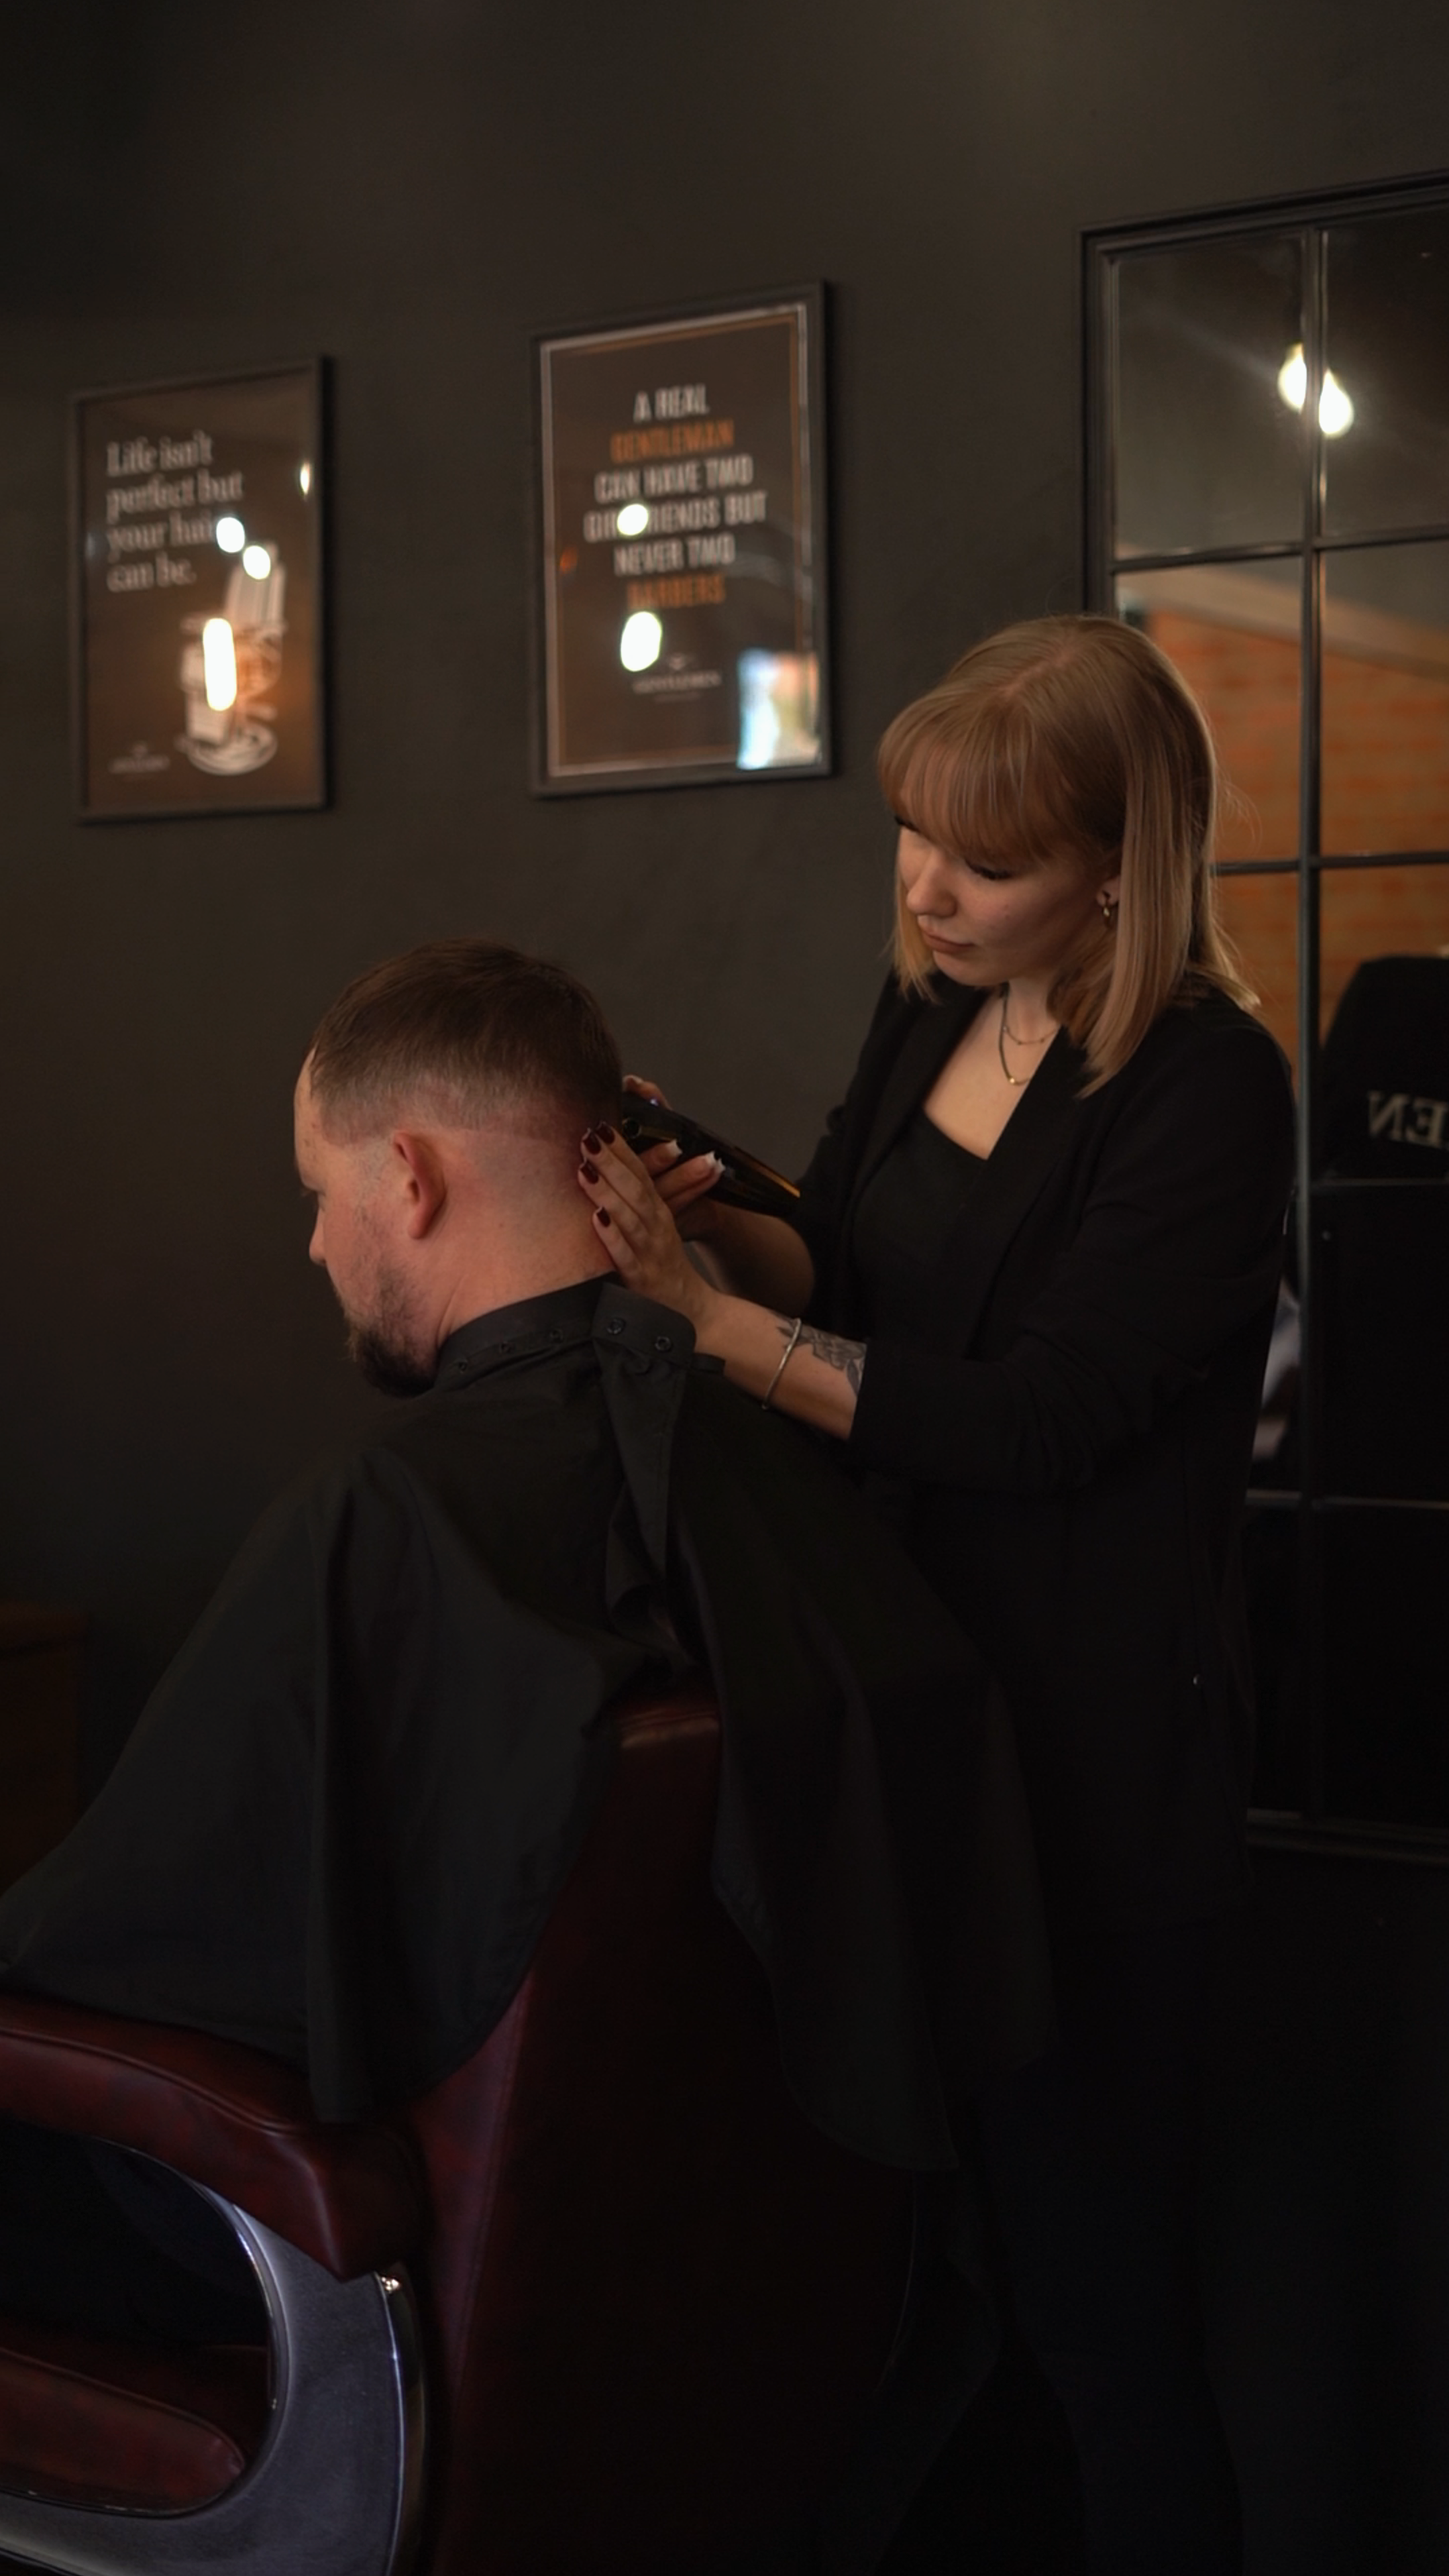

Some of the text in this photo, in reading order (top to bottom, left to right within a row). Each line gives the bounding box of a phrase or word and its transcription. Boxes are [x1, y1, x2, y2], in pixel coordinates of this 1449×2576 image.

[633, 383, 709, 423] A REAL
[107, 429, 213, 476] Life isn't
[610, 418, 734, 464] GENTLEMAN
[106, 468, 243, 524] perfect but
[594, 453, 753, 504] CAN HAVE TWO
[724, 490, 767, 526] BUT
[106, 509, 223, 563] your hai
[614, 532, 736, 577] NEVER TWO
[107, 550, 196, 592] can be.
[627, 573, 726, 608] BARBERS
